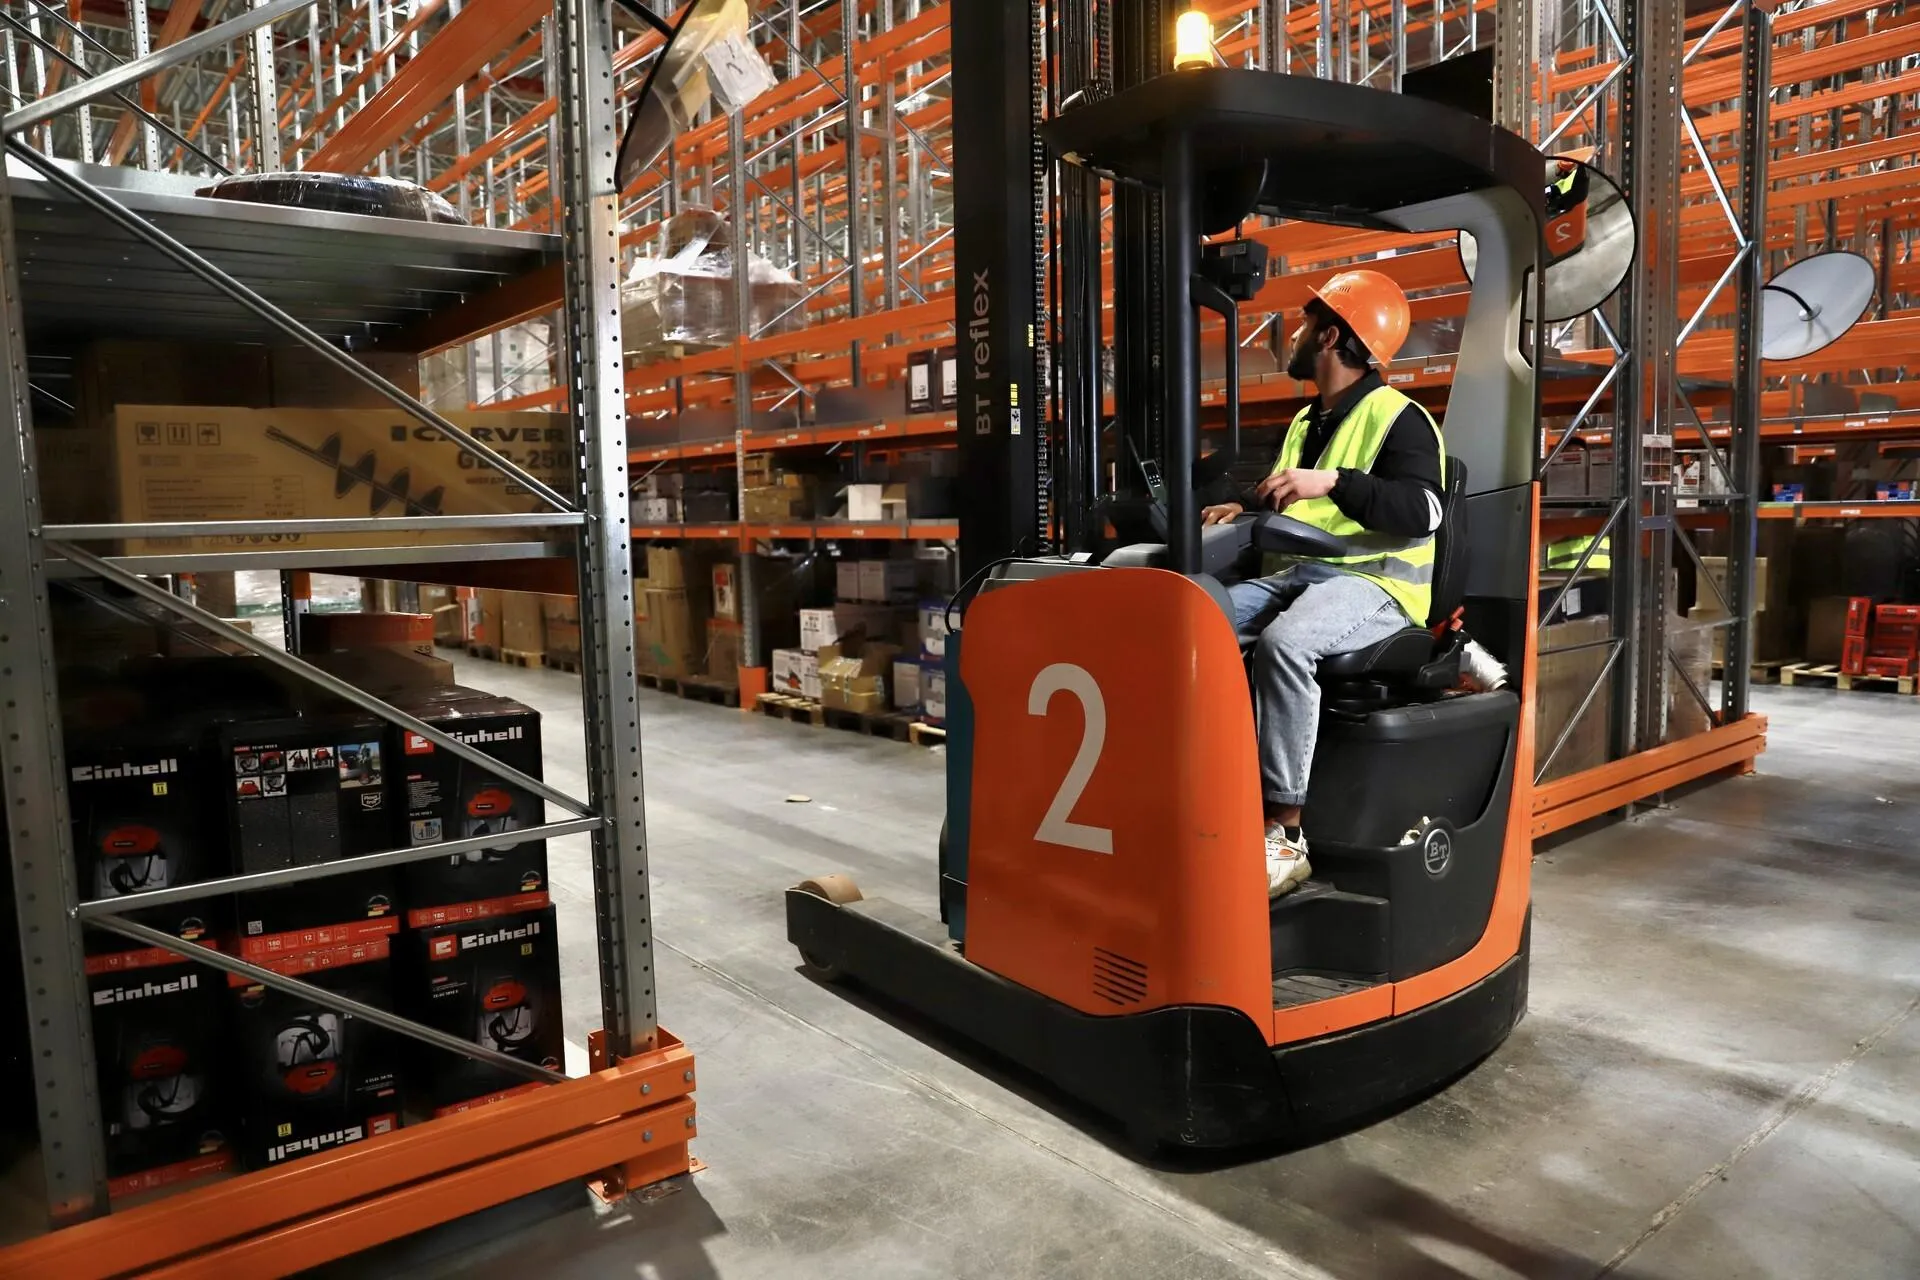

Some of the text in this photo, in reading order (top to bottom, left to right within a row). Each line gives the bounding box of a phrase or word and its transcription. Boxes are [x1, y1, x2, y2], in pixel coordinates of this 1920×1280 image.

[969, 267, 991, 435] BT reflex
[449, 726, 523, 744] inhell
[71, 758, 179, 782] Einhell
[1027, 662, 1113, 855] 2
[1429, 841, 1448, 860] BT
[461, 921, 541, 950] Einhell
[93, 974, 198, 1006] Einhell
[268, 1124, 363, 1162] Einhell
